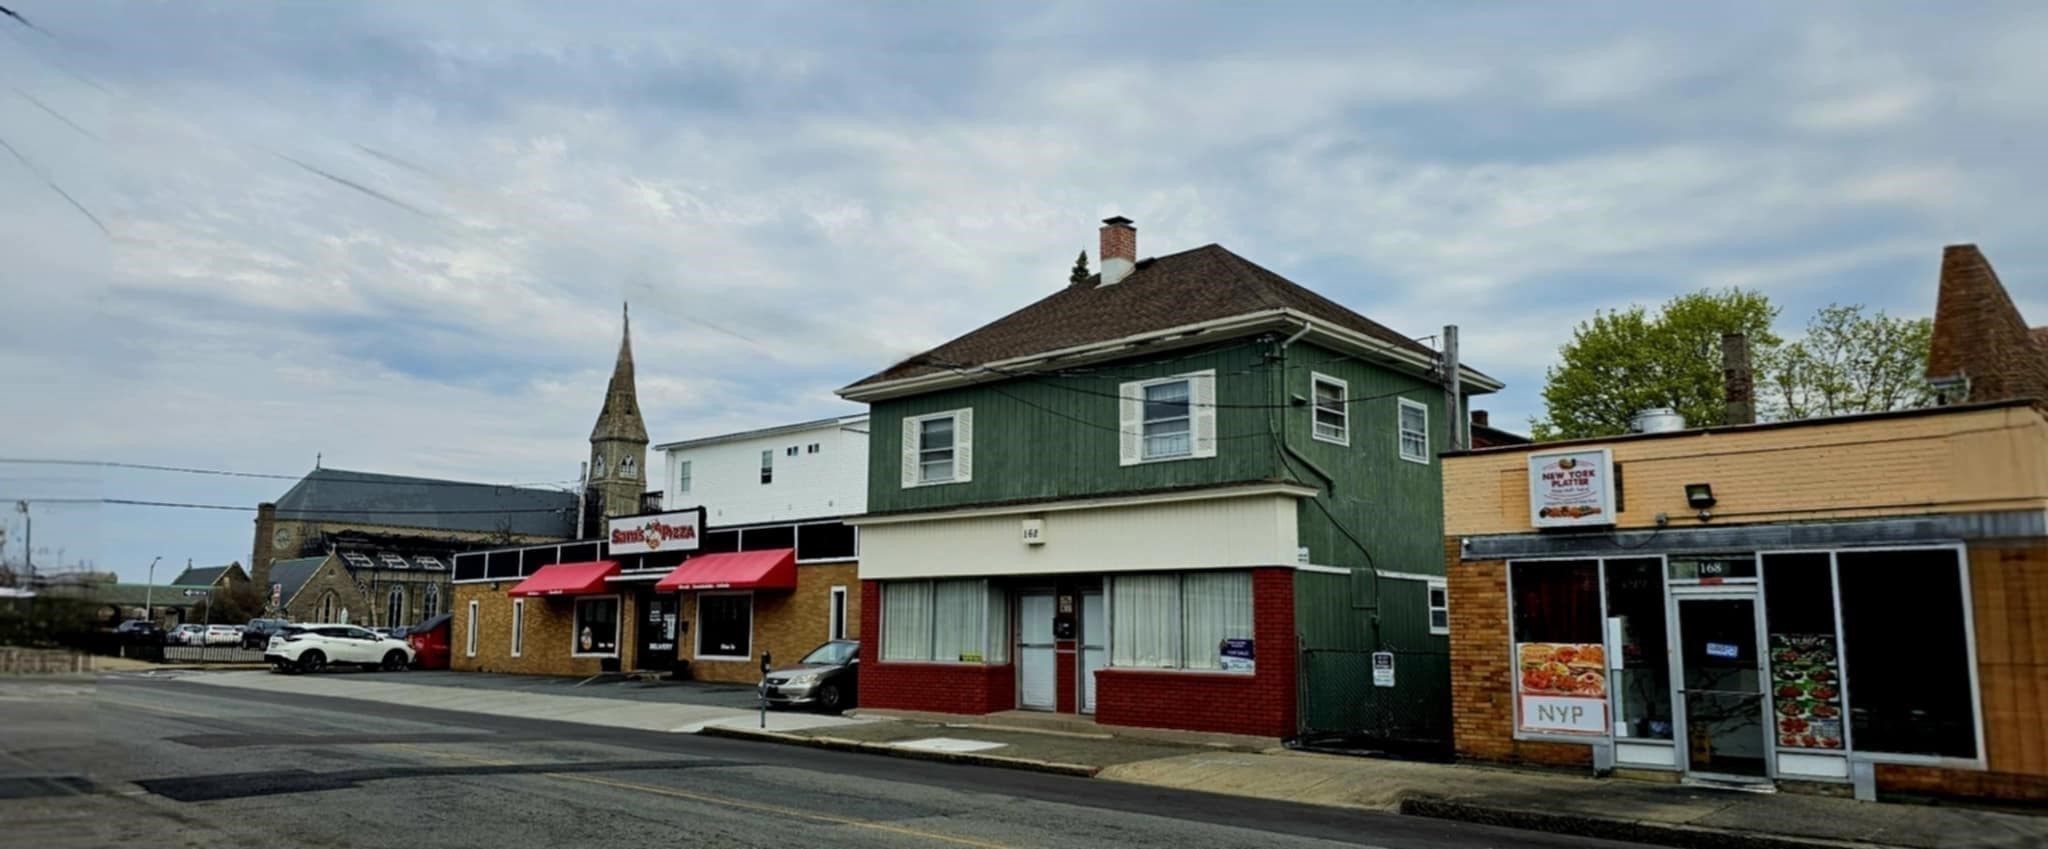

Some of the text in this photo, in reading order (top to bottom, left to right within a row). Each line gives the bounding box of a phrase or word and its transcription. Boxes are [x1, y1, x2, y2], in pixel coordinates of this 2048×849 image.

[1542, 469, 1595, 480] NEW YORK
[1551, 478, 1589, 488] PLATTER
[612, 526, 645, 544] Sam's
[1700, 562, 1722, 574] 168
[1538, 704, 1583, 724] NYP
